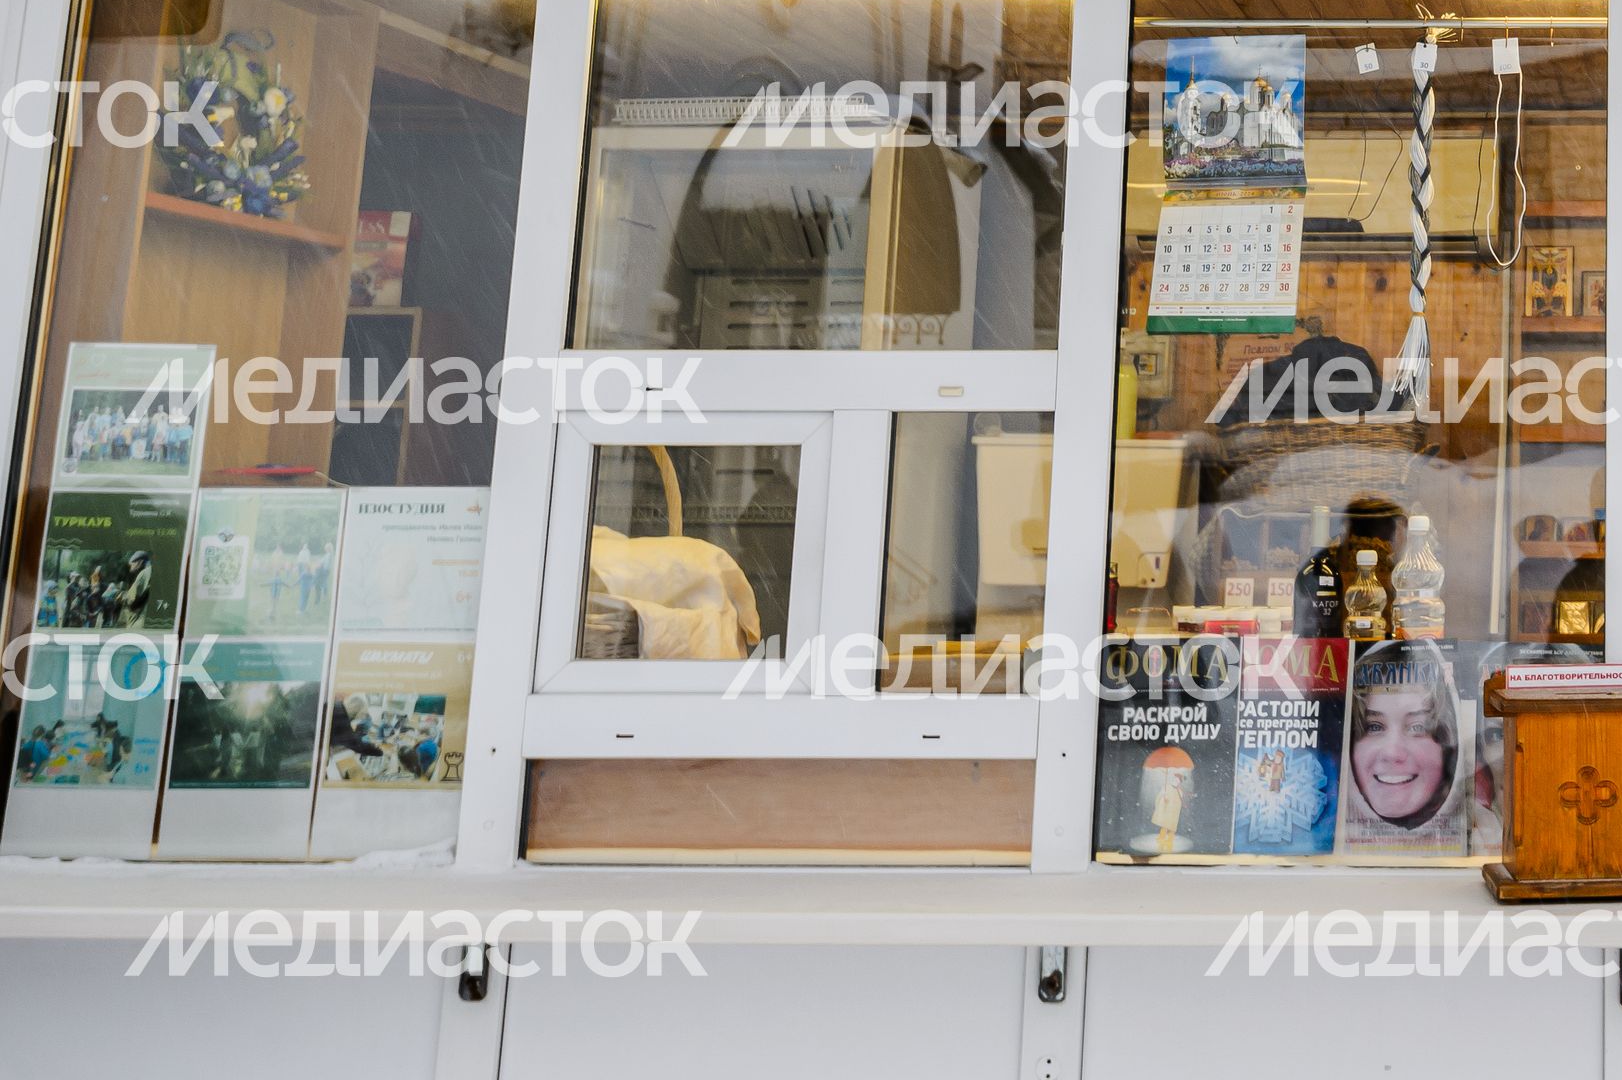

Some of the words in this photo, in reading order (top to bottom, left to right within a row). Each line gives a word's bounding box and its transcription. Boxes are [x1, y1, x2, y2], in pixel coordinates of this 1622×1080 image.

[1419, 61, 1429, 69] 30
[1164, 245, 1172, 253] 10
[1184, 245, 1192, 253] 11
[1203, 244, 1212, 253] 12
[1223, 244, 1232, 252] 13
[1243, 244, 1252, 252] 14
[1263, 244, 1272, 252] 15
[1283, 243, 1292, 252] 16
[1162, 265, 1171, 273] 17
[1182, 264, 1191, 273] 18
[1202, 264, 1211, 272] 19
[1221, 264, 1231, 272] 20
[1242, 264, 1251, 272] 21
[1261, 263, 1272, 271] 22
[1281, 263, 1291, 271] 23
[1159, 284, 1169, 292] 24
[1179, 284, 1190, 292] 25
[1200, 284, 1210, 292] 26
[1219, 283, 1229, 291] 27
[1239, 283, 1249, 291] 28
[1259, 283, 1270, 291] 29
[1279, 283, 1290, 291] 30
[358, 503, 446, 515] ИЗОСТУДИЯ
[54, 516, 112, 528] ТУРКЛУБ
[1227, 582, 1251, 596] 250
[1269, 581, 1293, 596] 150
[1323, 608, 1332, 616] 32
[359, 649, 434, 664] ШАХМАТЫ
[1106, 644, 1231, 685] ФОМА
[1258, 644, 1340, 683] ОМА
[1123, 703, 1207, 723] РАСКРОЙ
[1240, 719, 1254, 728] се
[1257, 718, 1319, 730] преграды
[1107, 724, 1160, 741] СВОЮ
[1165, 723, 1221, 743] ДУШУ
